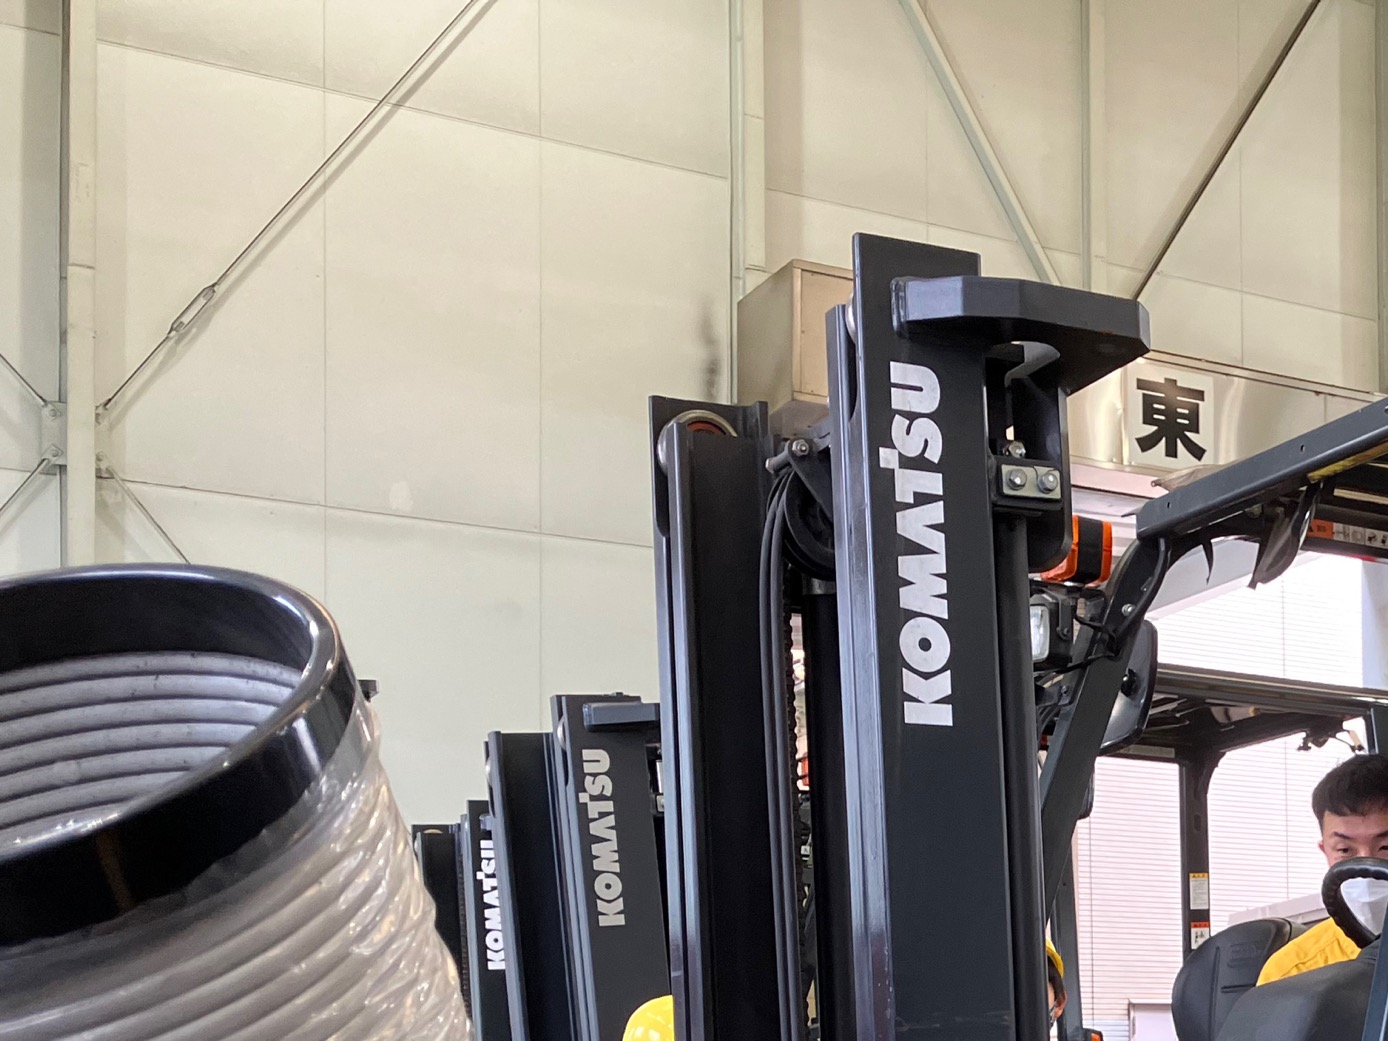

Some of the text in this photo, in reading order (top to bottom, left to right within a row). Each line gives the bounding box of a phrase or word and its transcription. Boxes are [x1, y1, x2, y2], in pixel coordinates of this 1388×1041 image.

[1135, 377, 1207, 462] 東
[879, 361, 953, 727] KOMATSU
[579, 749, 626, 926] KOMATSU
